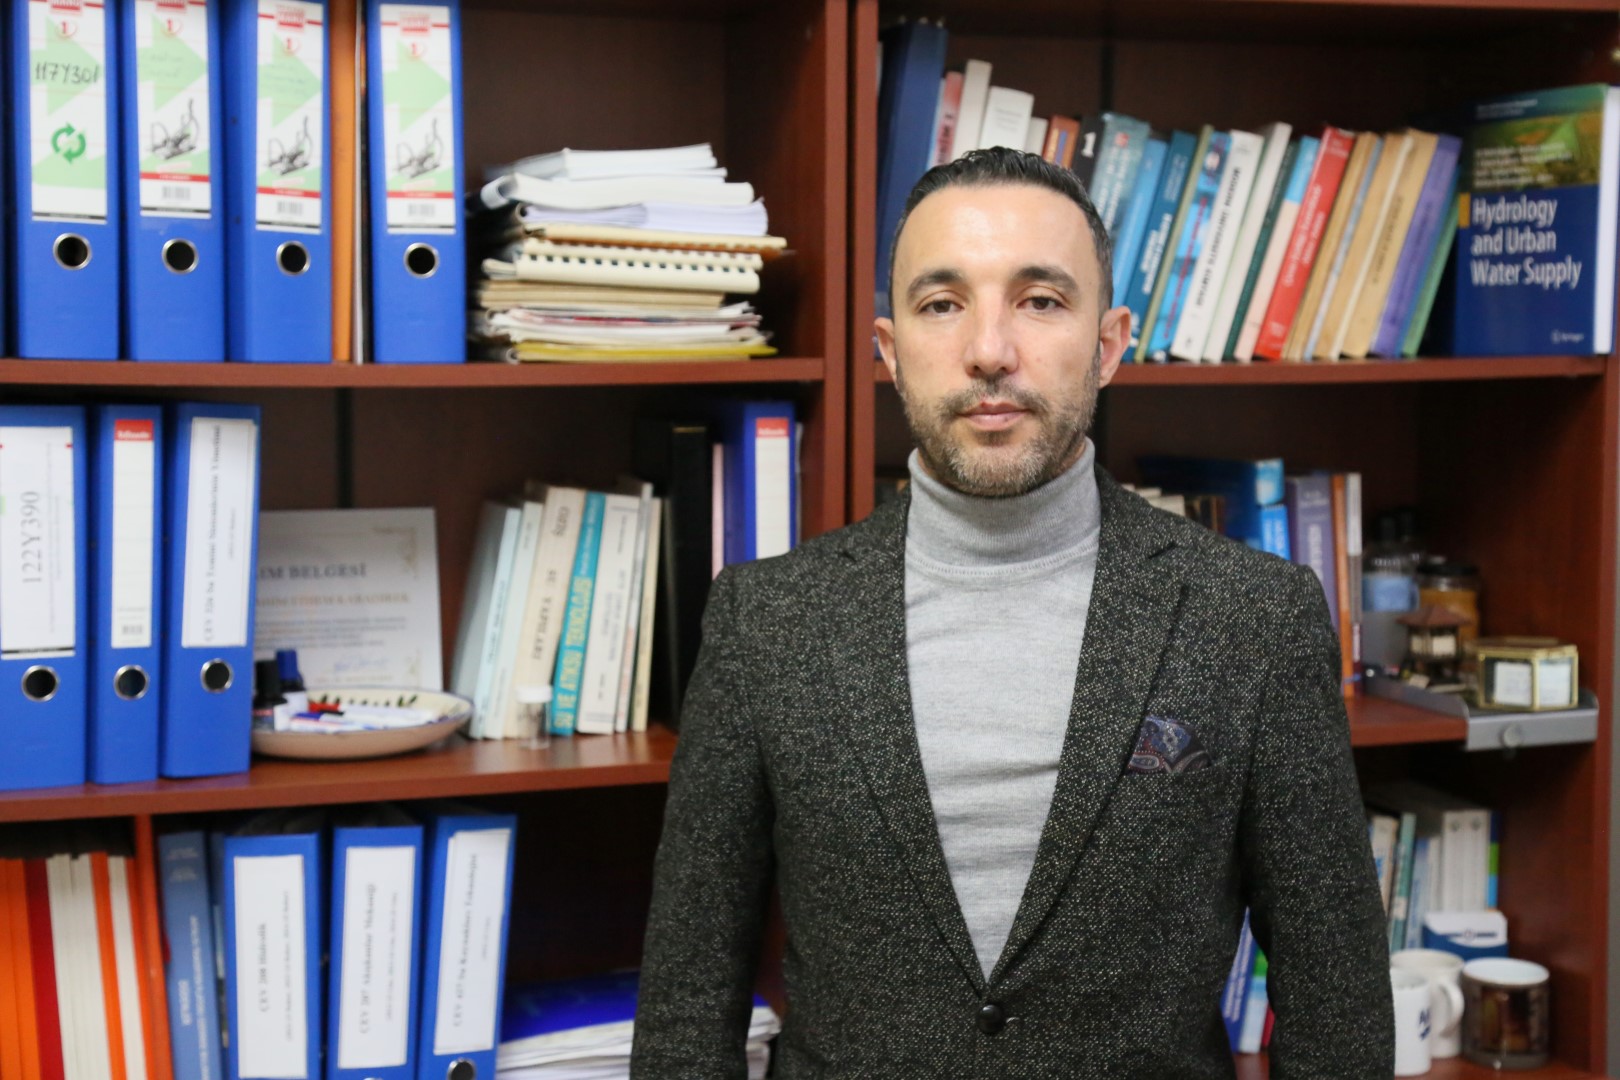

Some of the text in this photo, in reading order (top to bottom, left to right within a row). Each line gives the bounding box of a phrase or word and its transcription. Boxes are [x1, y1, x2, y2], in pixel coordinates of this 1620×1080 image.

[1081, 131, 1097, 159] 1
[1472, 194, 1558, 231] Hydrology
[1471, 225, 1557, 256] and Urban
[1470, 254, 1583, 290] Water Supply
[20, 490, 43, 584] 122Y390
[289, 562, 367, 579] BELGESİ
[557, 692, 577, 708] VE
